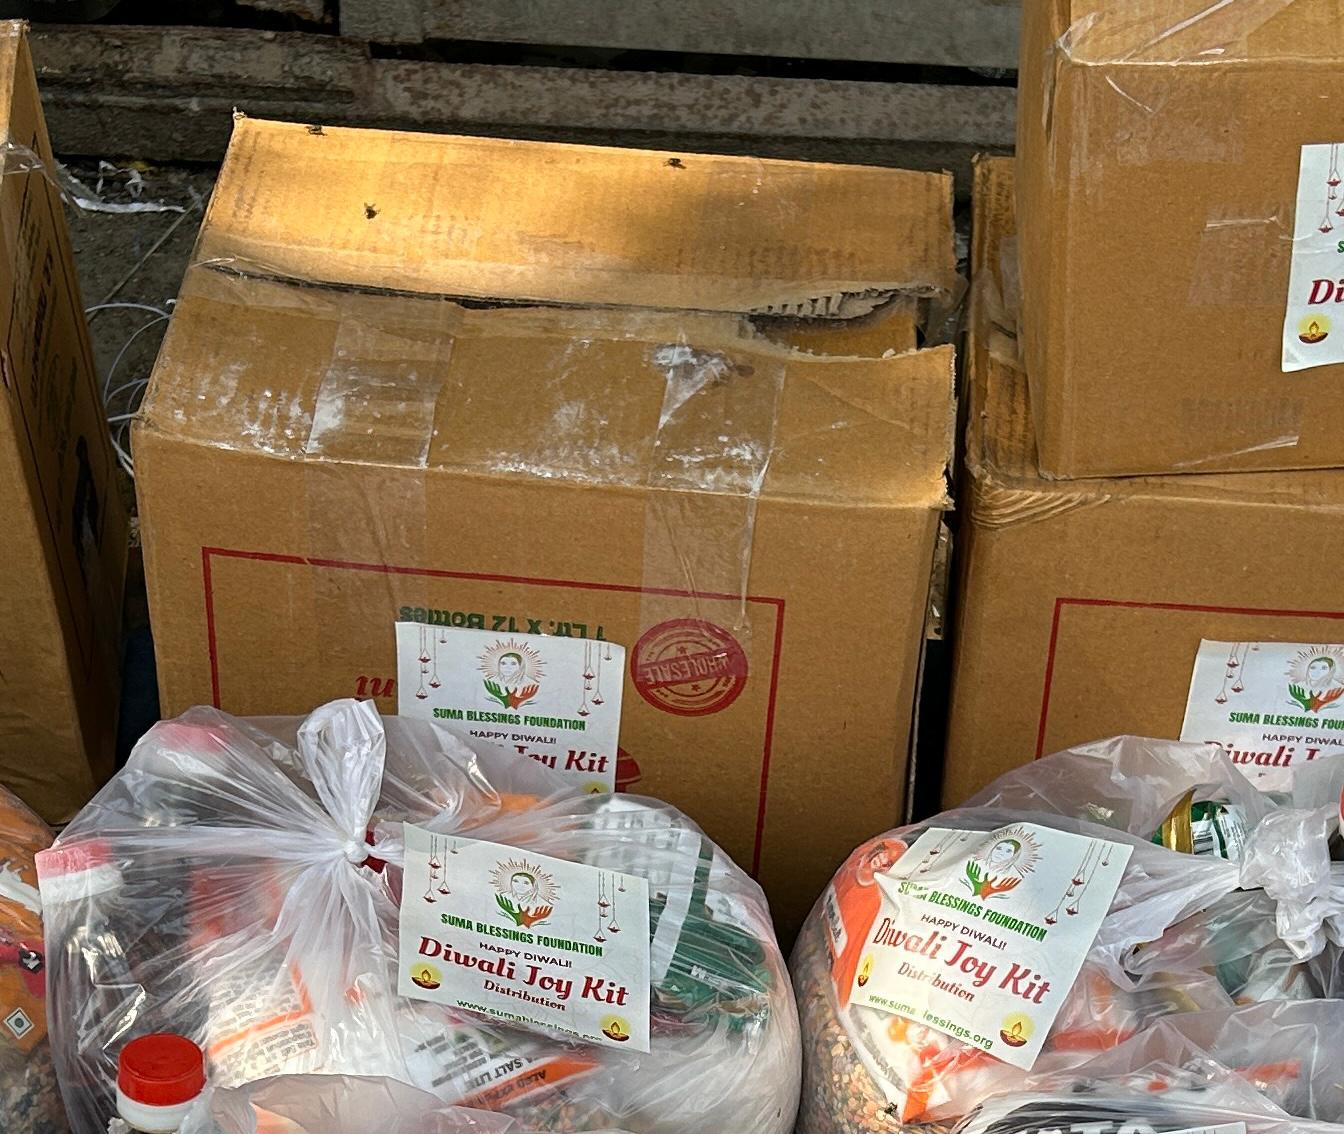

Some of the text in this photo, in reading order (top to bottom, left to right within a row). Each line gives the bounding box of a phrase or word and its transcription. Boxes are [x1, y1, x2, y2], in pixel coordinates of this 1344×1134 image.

[643, 653, 729, 684] WHOLESALE
[433, 708, 586, 731] SUMA BLESSINGS FOUNDATION
[1229, 712, 1260, 724] SUMA
[1263, 714, 1319, 728] BLESSINGS
[564, 750, 609, 773] Kit
[928, 889, 983, 917] BLESSINGS
[982, 908, 1048, 942] FOUNDATION
[441, 914, 602, 957] SUMA BLESSINGS FOUNDATION
[418, 936, 628, 1006] Diwali Joy Kit
[944, 941, 1050, 1004] Joy Kit
[483, 980, 566, 1011] Distribution
